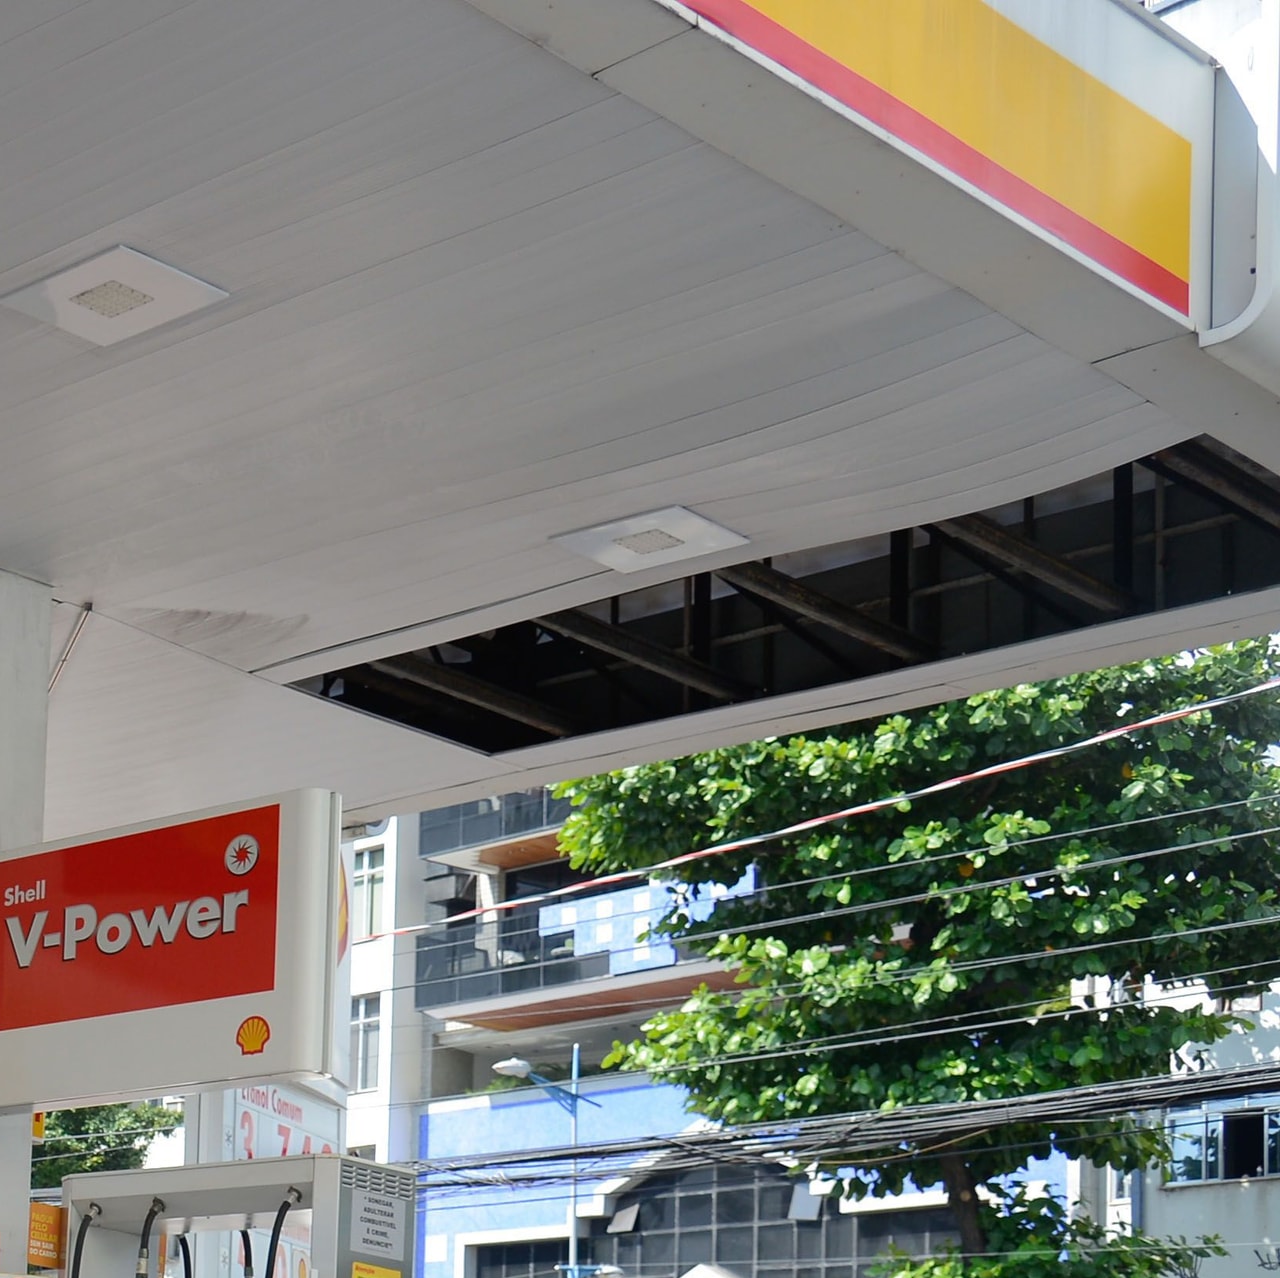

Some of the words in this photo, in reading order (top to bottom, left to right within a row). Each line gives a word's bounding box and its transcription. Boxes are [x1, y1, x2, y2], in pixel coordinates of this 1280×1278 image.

[4, 879, 46, 907] Shell
[5, 889, 249, 969] V-Power
[271, 1089, 303, 1123] Comum
[31, 1222, 48, 1231] PELO
